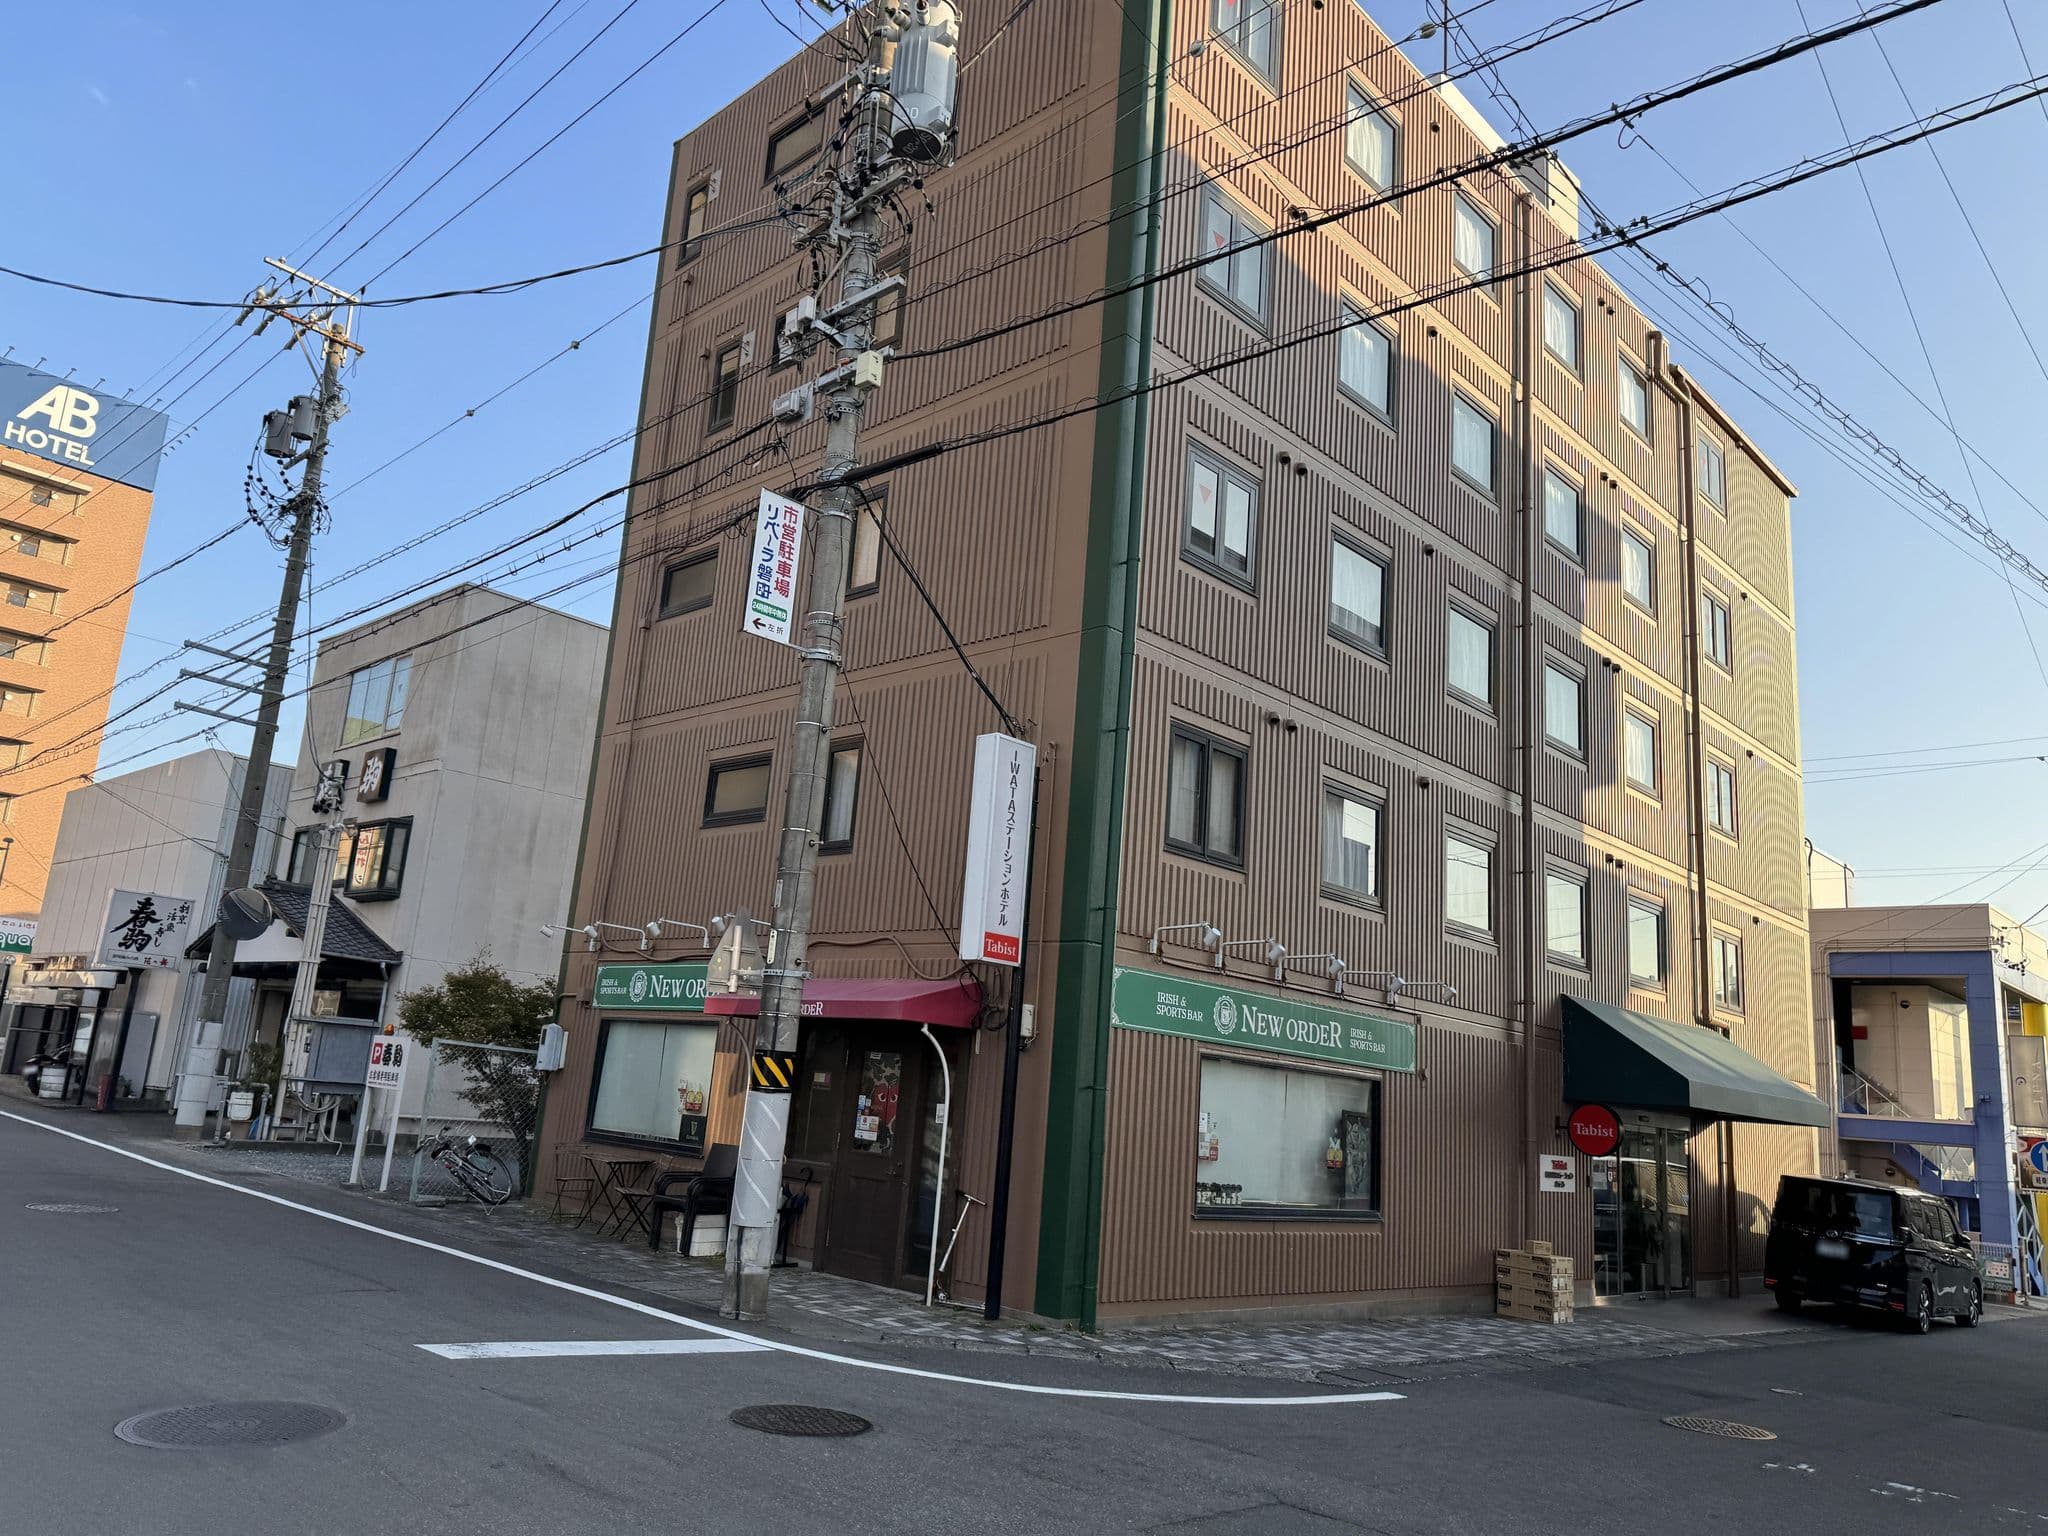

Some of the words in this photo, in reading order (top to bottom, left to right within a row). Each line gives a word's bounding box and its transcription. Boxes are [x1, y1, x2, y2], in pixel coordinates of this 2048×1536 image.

[16, 384, 99, 438] AB
[4, 420, 95, 466] HOTEL
[774, 504, 799, 599] 市営駐車場
[998, 750, 1021, 927] IWATAステーションホテル
[110, 896, 163, 953] 春駒
[985, 938, 1017, 957] Tabist
[649, 975, 685, 998] NEW
[1157, 992, 1179, 1006] IRISH
[1180, 996, 1188, 1007] &
[1156, 1004, 1187, 1019] SPORTS
[1187, 1010, 1204, 1022] BAR
[1241, 1004, 1285, 1038] NEW
[1286, 1018, 1342, 1049] ORDER
[1350, 1027, 1367, 1040] IRISH
[1367, 1031, 1373, 1041] &
[373, 1046, 382, 1061] P
[1349, 1038, 1373, 1052] SPORTS
[1373, 1042, 1386, 1054] BAR
[1573, 1122, 1614, 1138] Tabist
